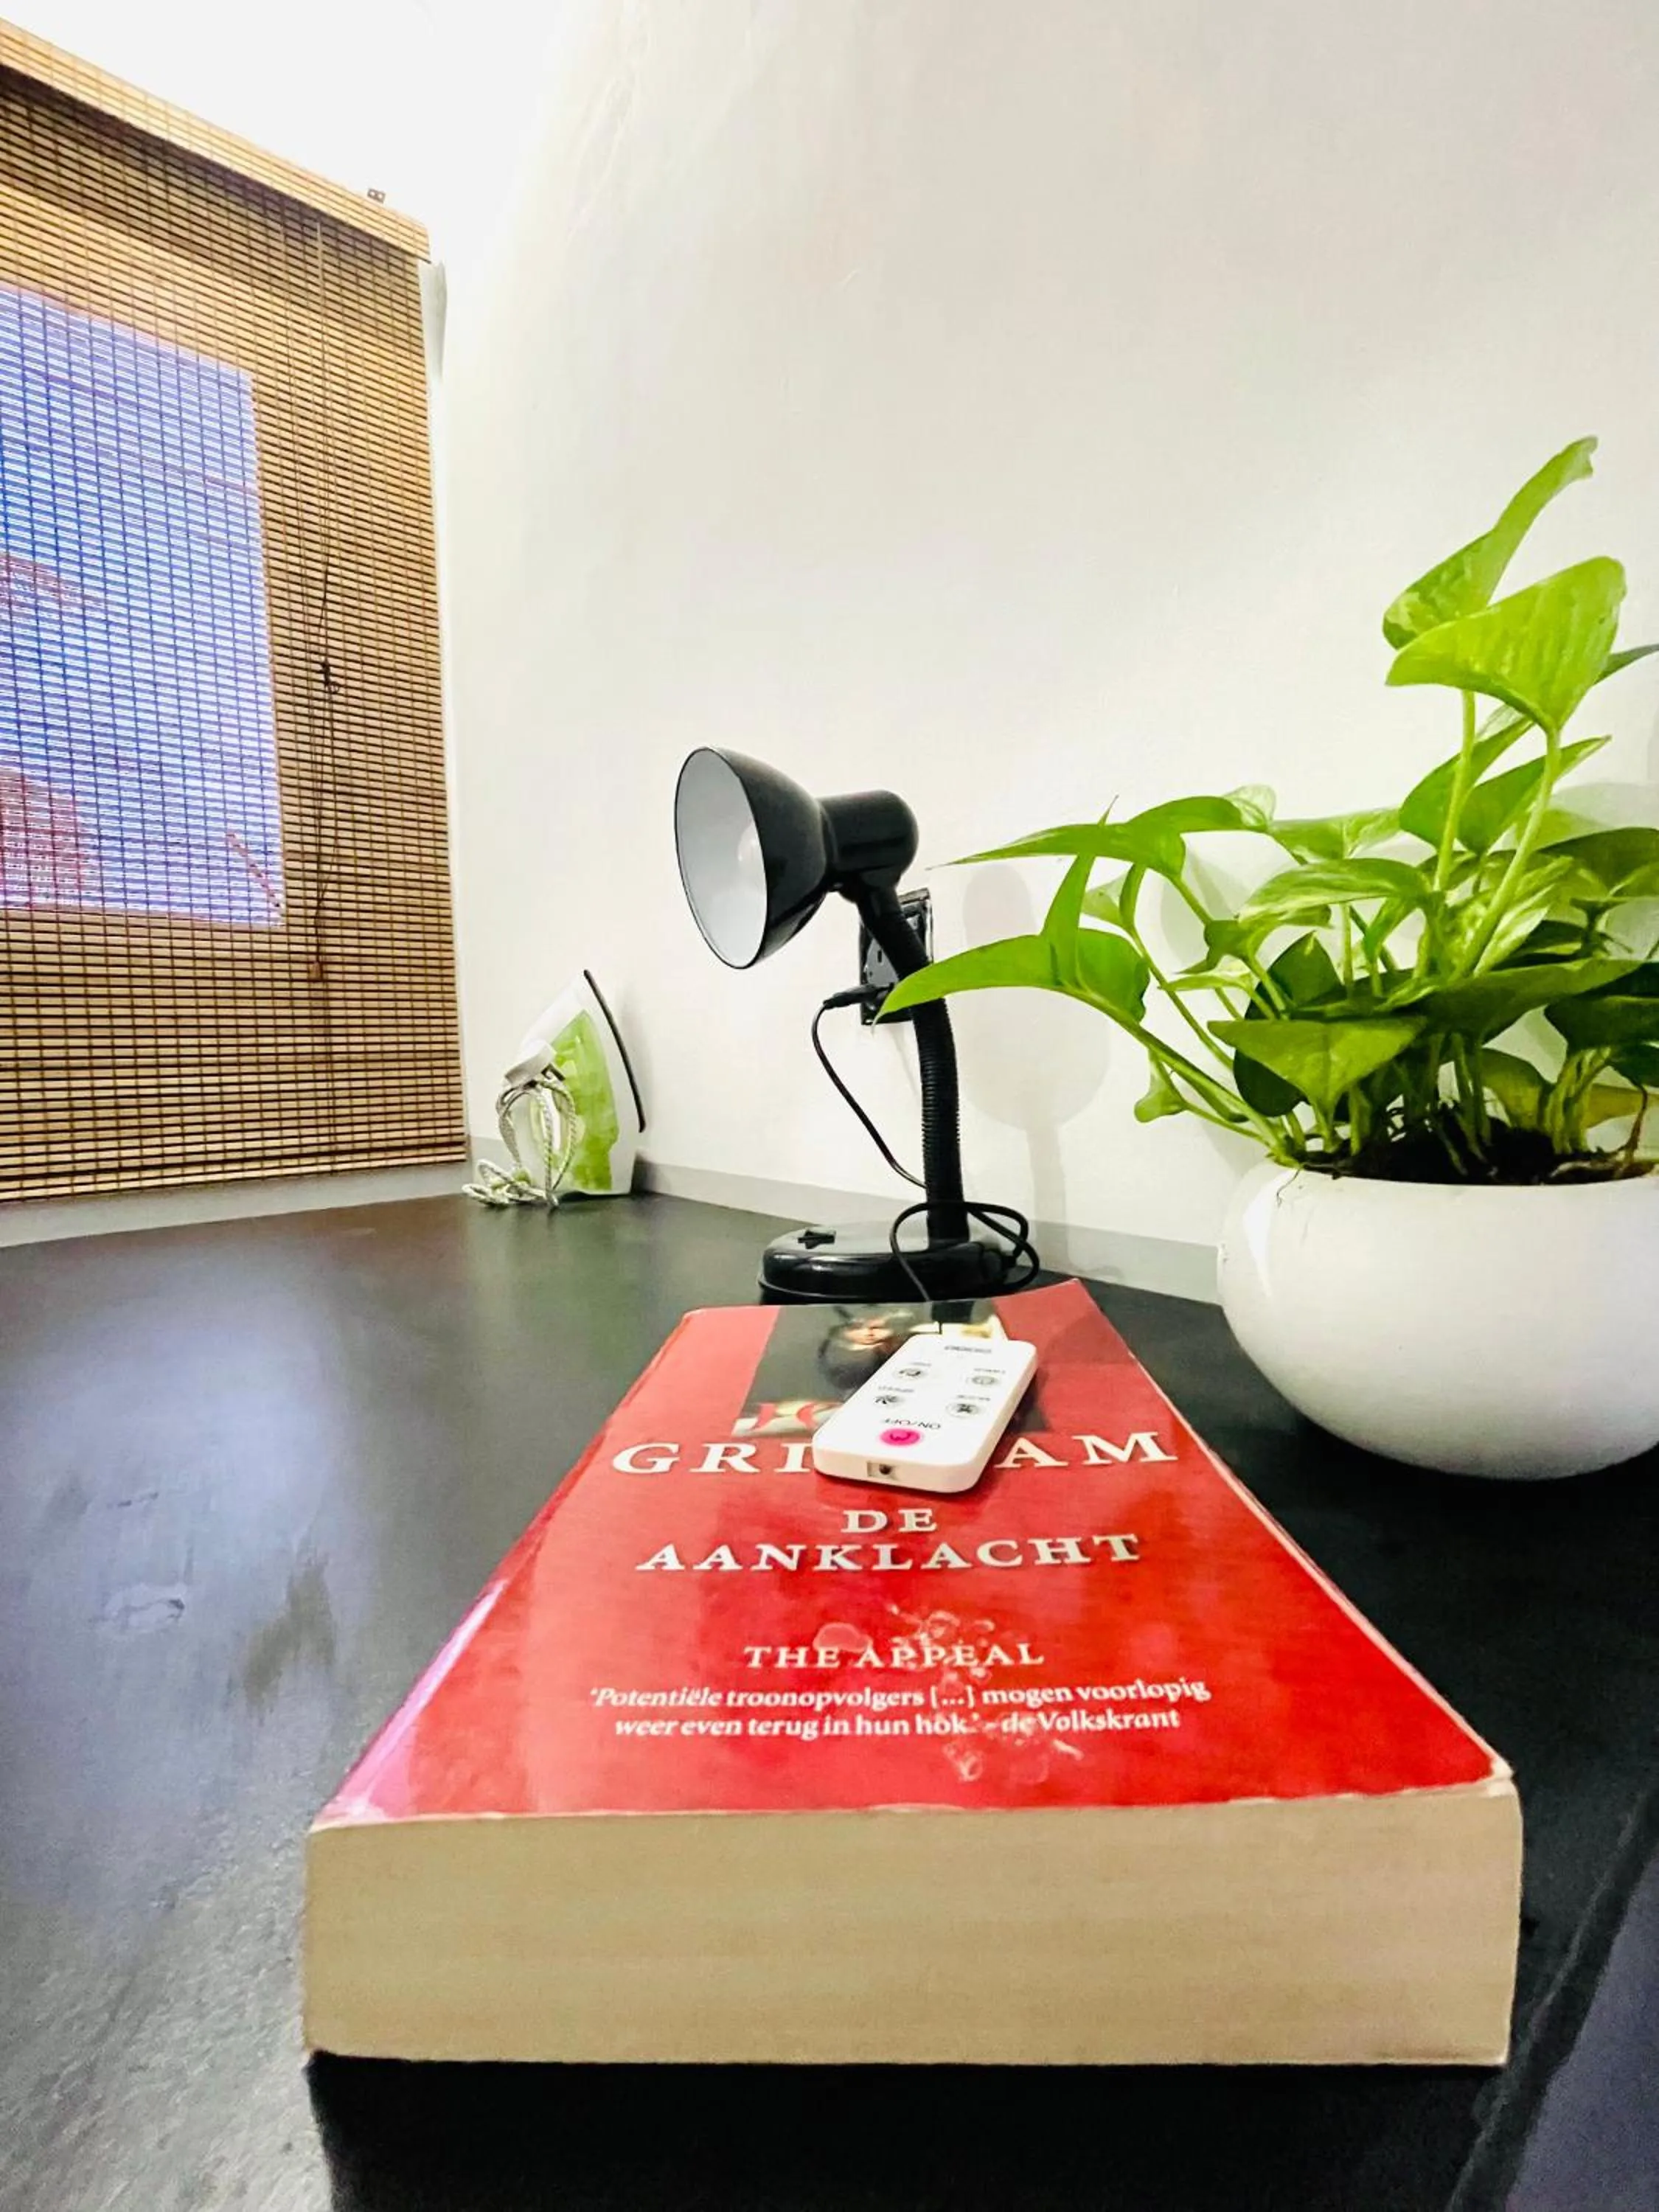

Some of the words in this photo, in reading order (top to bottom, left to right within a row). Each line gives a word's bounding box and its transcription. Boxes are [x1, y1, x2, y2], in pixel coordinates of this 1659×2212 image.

[612, 1431, 1178, 1474] GRIAM
[841, 1509, 938, 1535] DE
[636, 1534, 1140, 1571] AANKLACHT
[744, 1646, 840, 1669] THE
[849, 1642, 1045, 1669] APPEAL
[726, 1686, 925, 1711] troonopvolgers
[981, 1685, 1074, 1708] mogen
[1076, 1676, 1211, 1703] voorlopig
[614, 1718, 679, 1736] weer
[681, 1719, 742, 1736] even
[747, 1717, 818, 1741] terug
[822, 1714, 849, 1735] in
[855, 1714, 910, 1736] hun
[1001, 1714, 1037, 1734] de
[1036, 1708, 1181, 1732] Volkskrant
